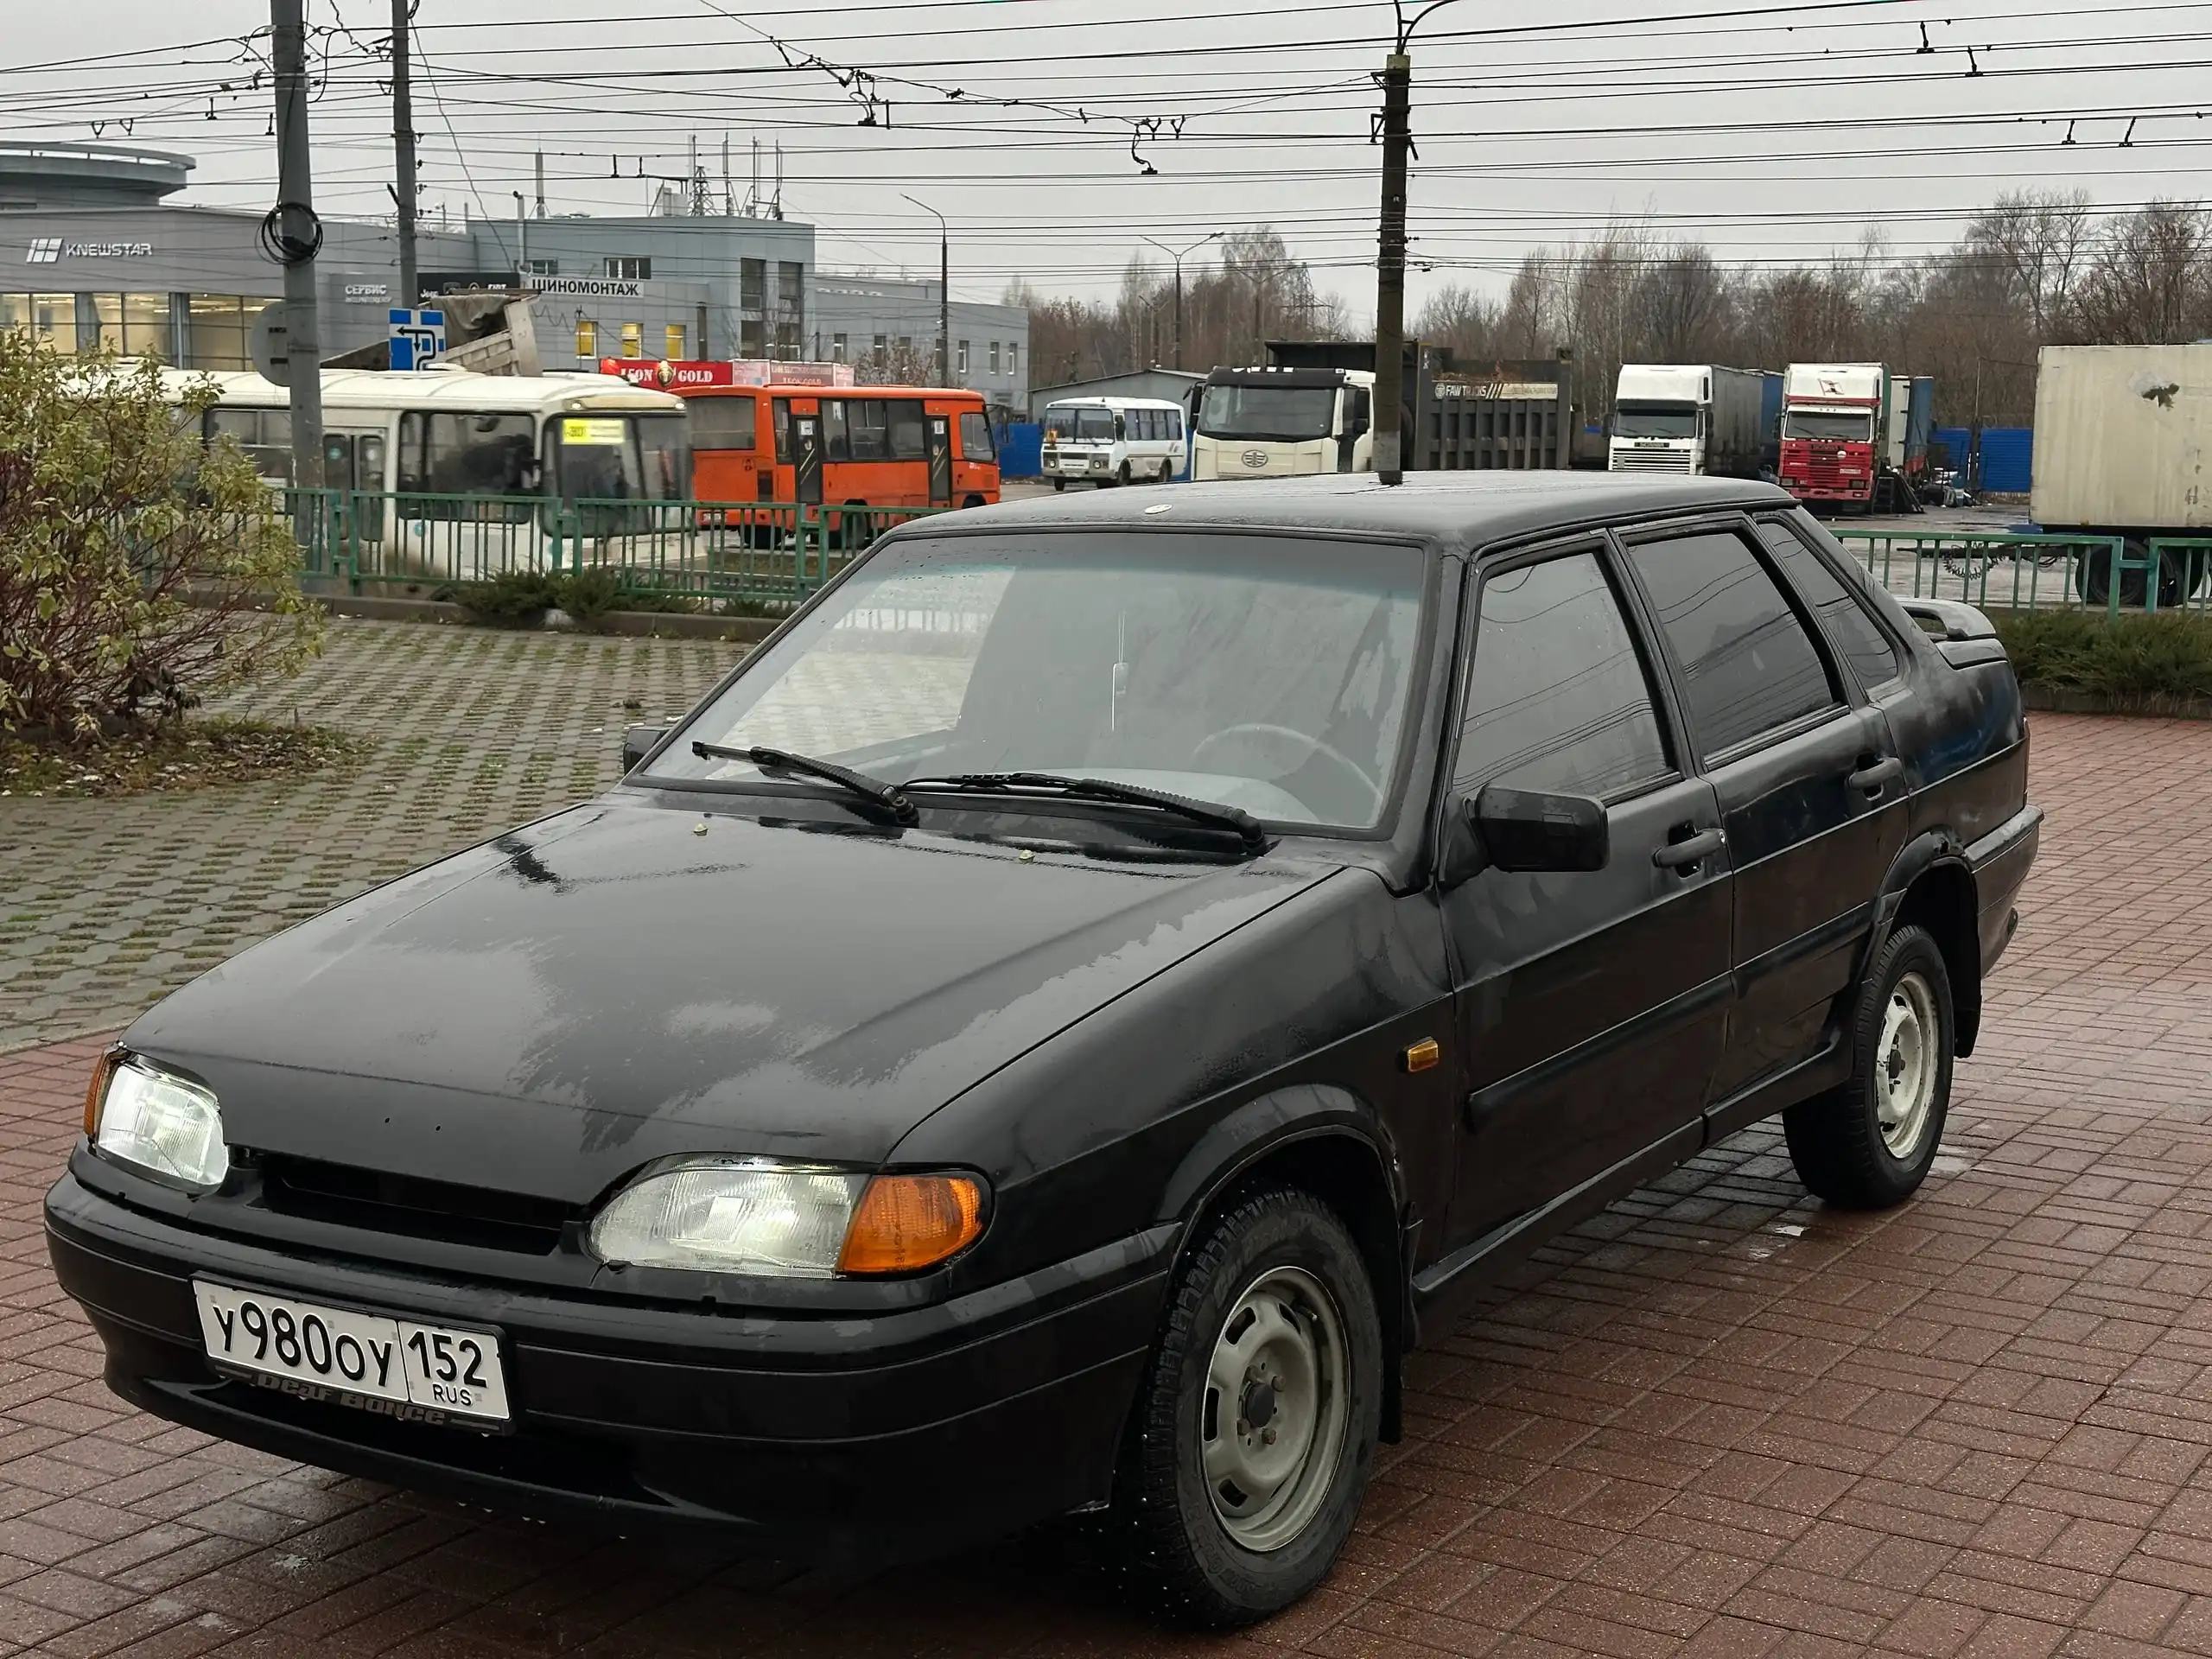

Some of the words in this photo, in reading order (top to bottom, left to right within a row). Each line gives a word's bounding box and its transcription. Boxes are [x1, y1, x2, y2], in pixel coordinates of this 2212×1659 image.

[67, 243, 153, 257] KNEWSTAR
[346, 284, 388, 296] СЕРВИС
[532, 278, 639, 296] ШИНОМОНТАЖ
[677, 370, 714, 383] GOLD
[1446, 385, 1462, 397] FAW
[408, 1331, 487, 1388] 152
[433, 1383, 473, 1407] RUS
